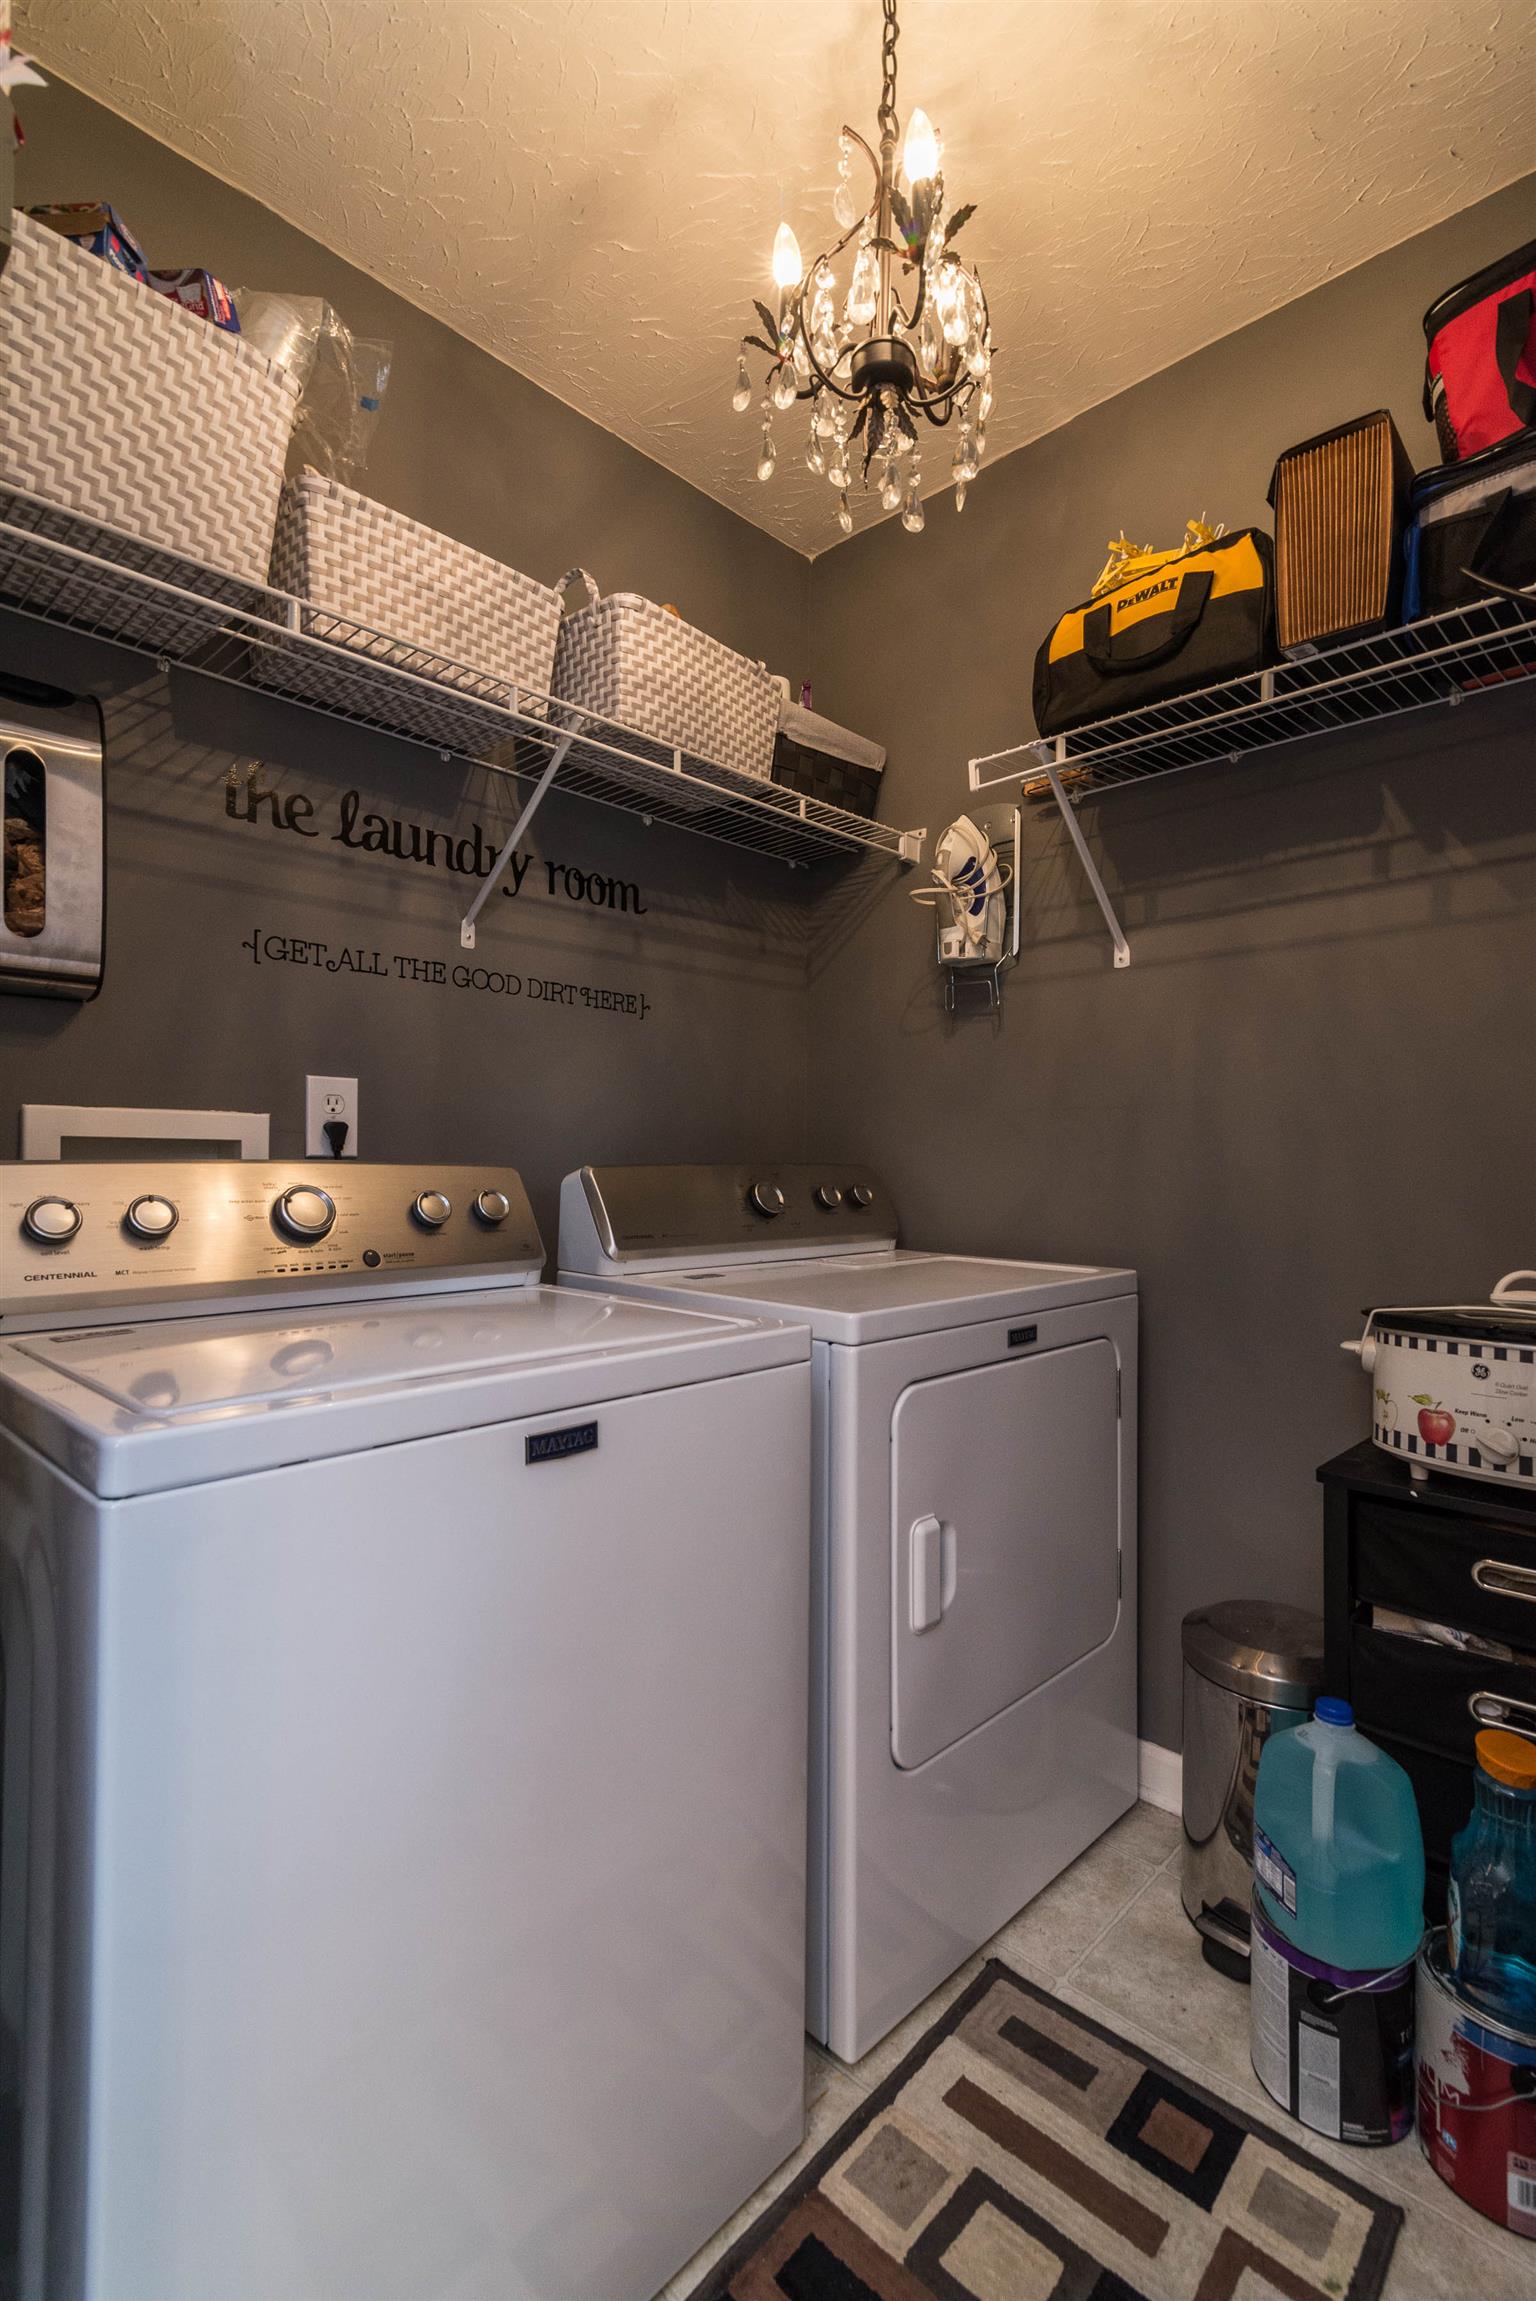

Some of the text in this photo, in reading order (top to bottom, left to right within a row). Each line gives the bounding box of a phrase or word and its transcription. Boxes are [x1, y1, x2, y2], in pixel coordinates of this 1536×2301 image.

[221, 760, 648, 915] the laundry room
[326, 948, 388, 976] ALL
[393, 954, 447, 985] THE
[452, 965, 521, 996] GOOD
[527, 977, 580, 1006] DIRT
[24, 1271, 98, 1282] CENTENNIAL
[530, 1430, 596, 1458] MAYTAG
